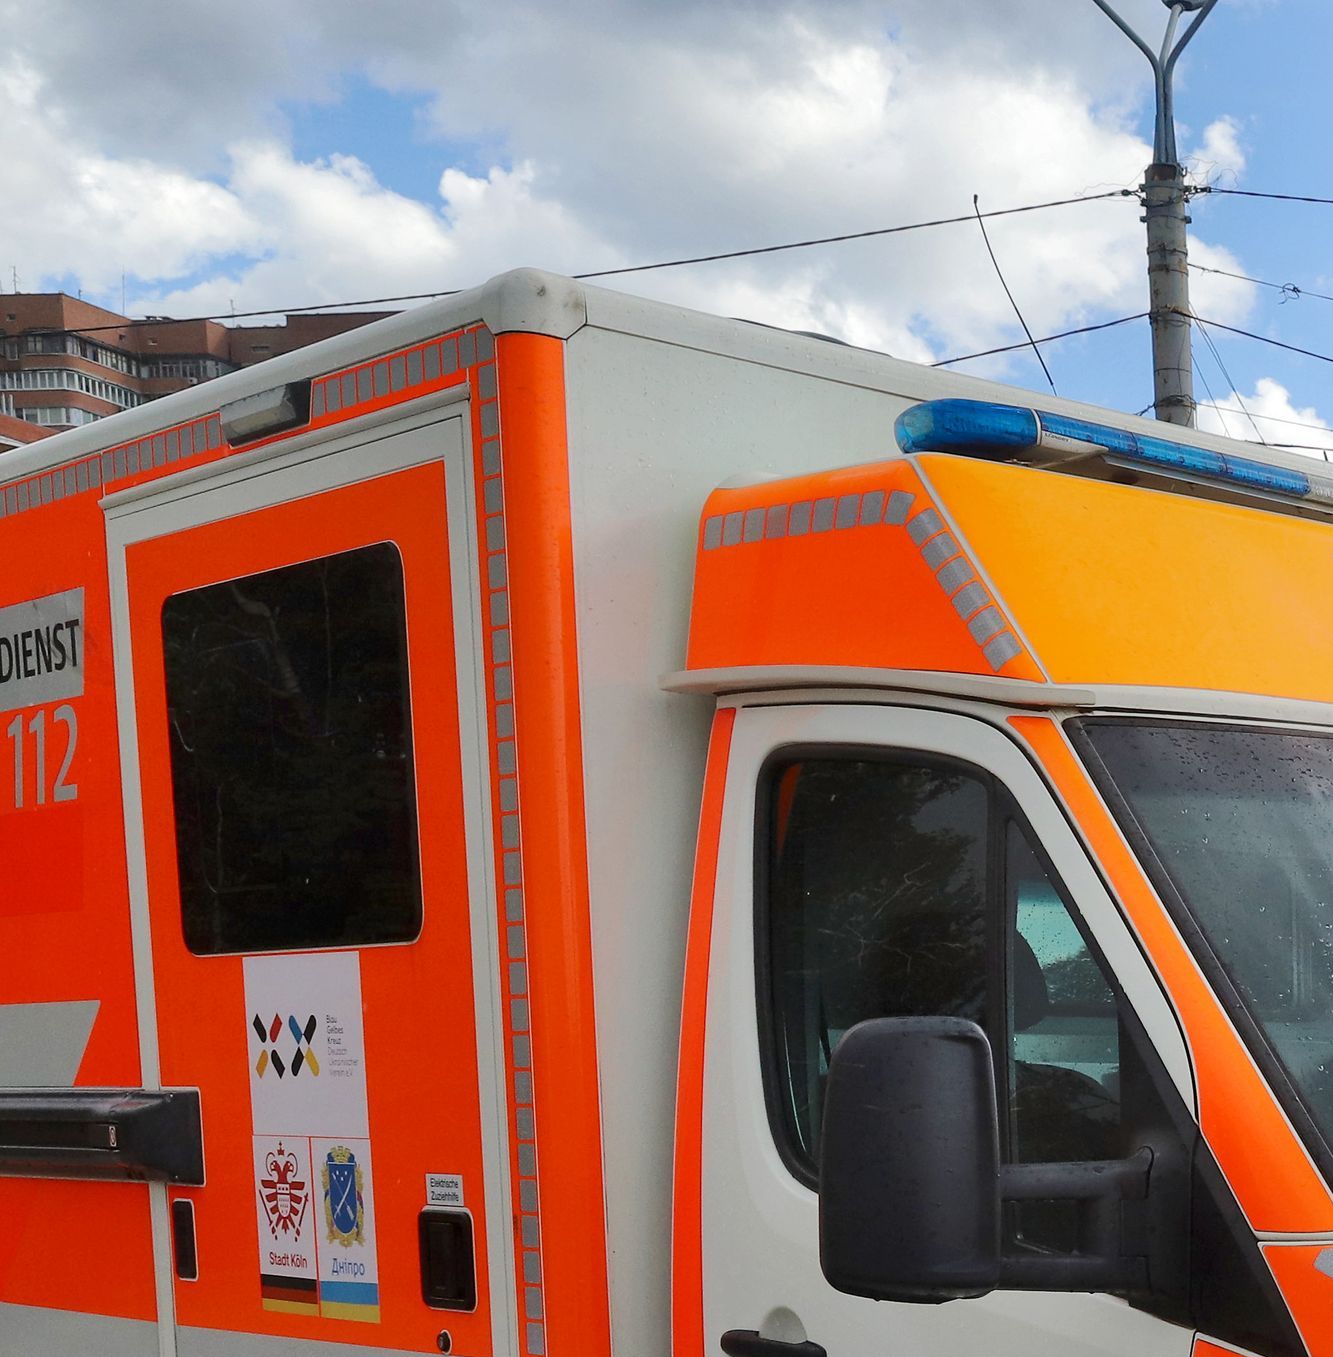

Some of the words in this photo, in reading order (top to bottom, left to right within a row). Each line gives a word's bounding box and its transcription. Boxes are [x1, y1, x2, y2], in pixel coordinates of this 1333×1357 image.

[7, 704, 78, 809] 112
[269, 1251, 290, 1267] Stadt
[290, 1254, 308, 1269] Köln
[331, 1257, 366, 1278] Дніпро
